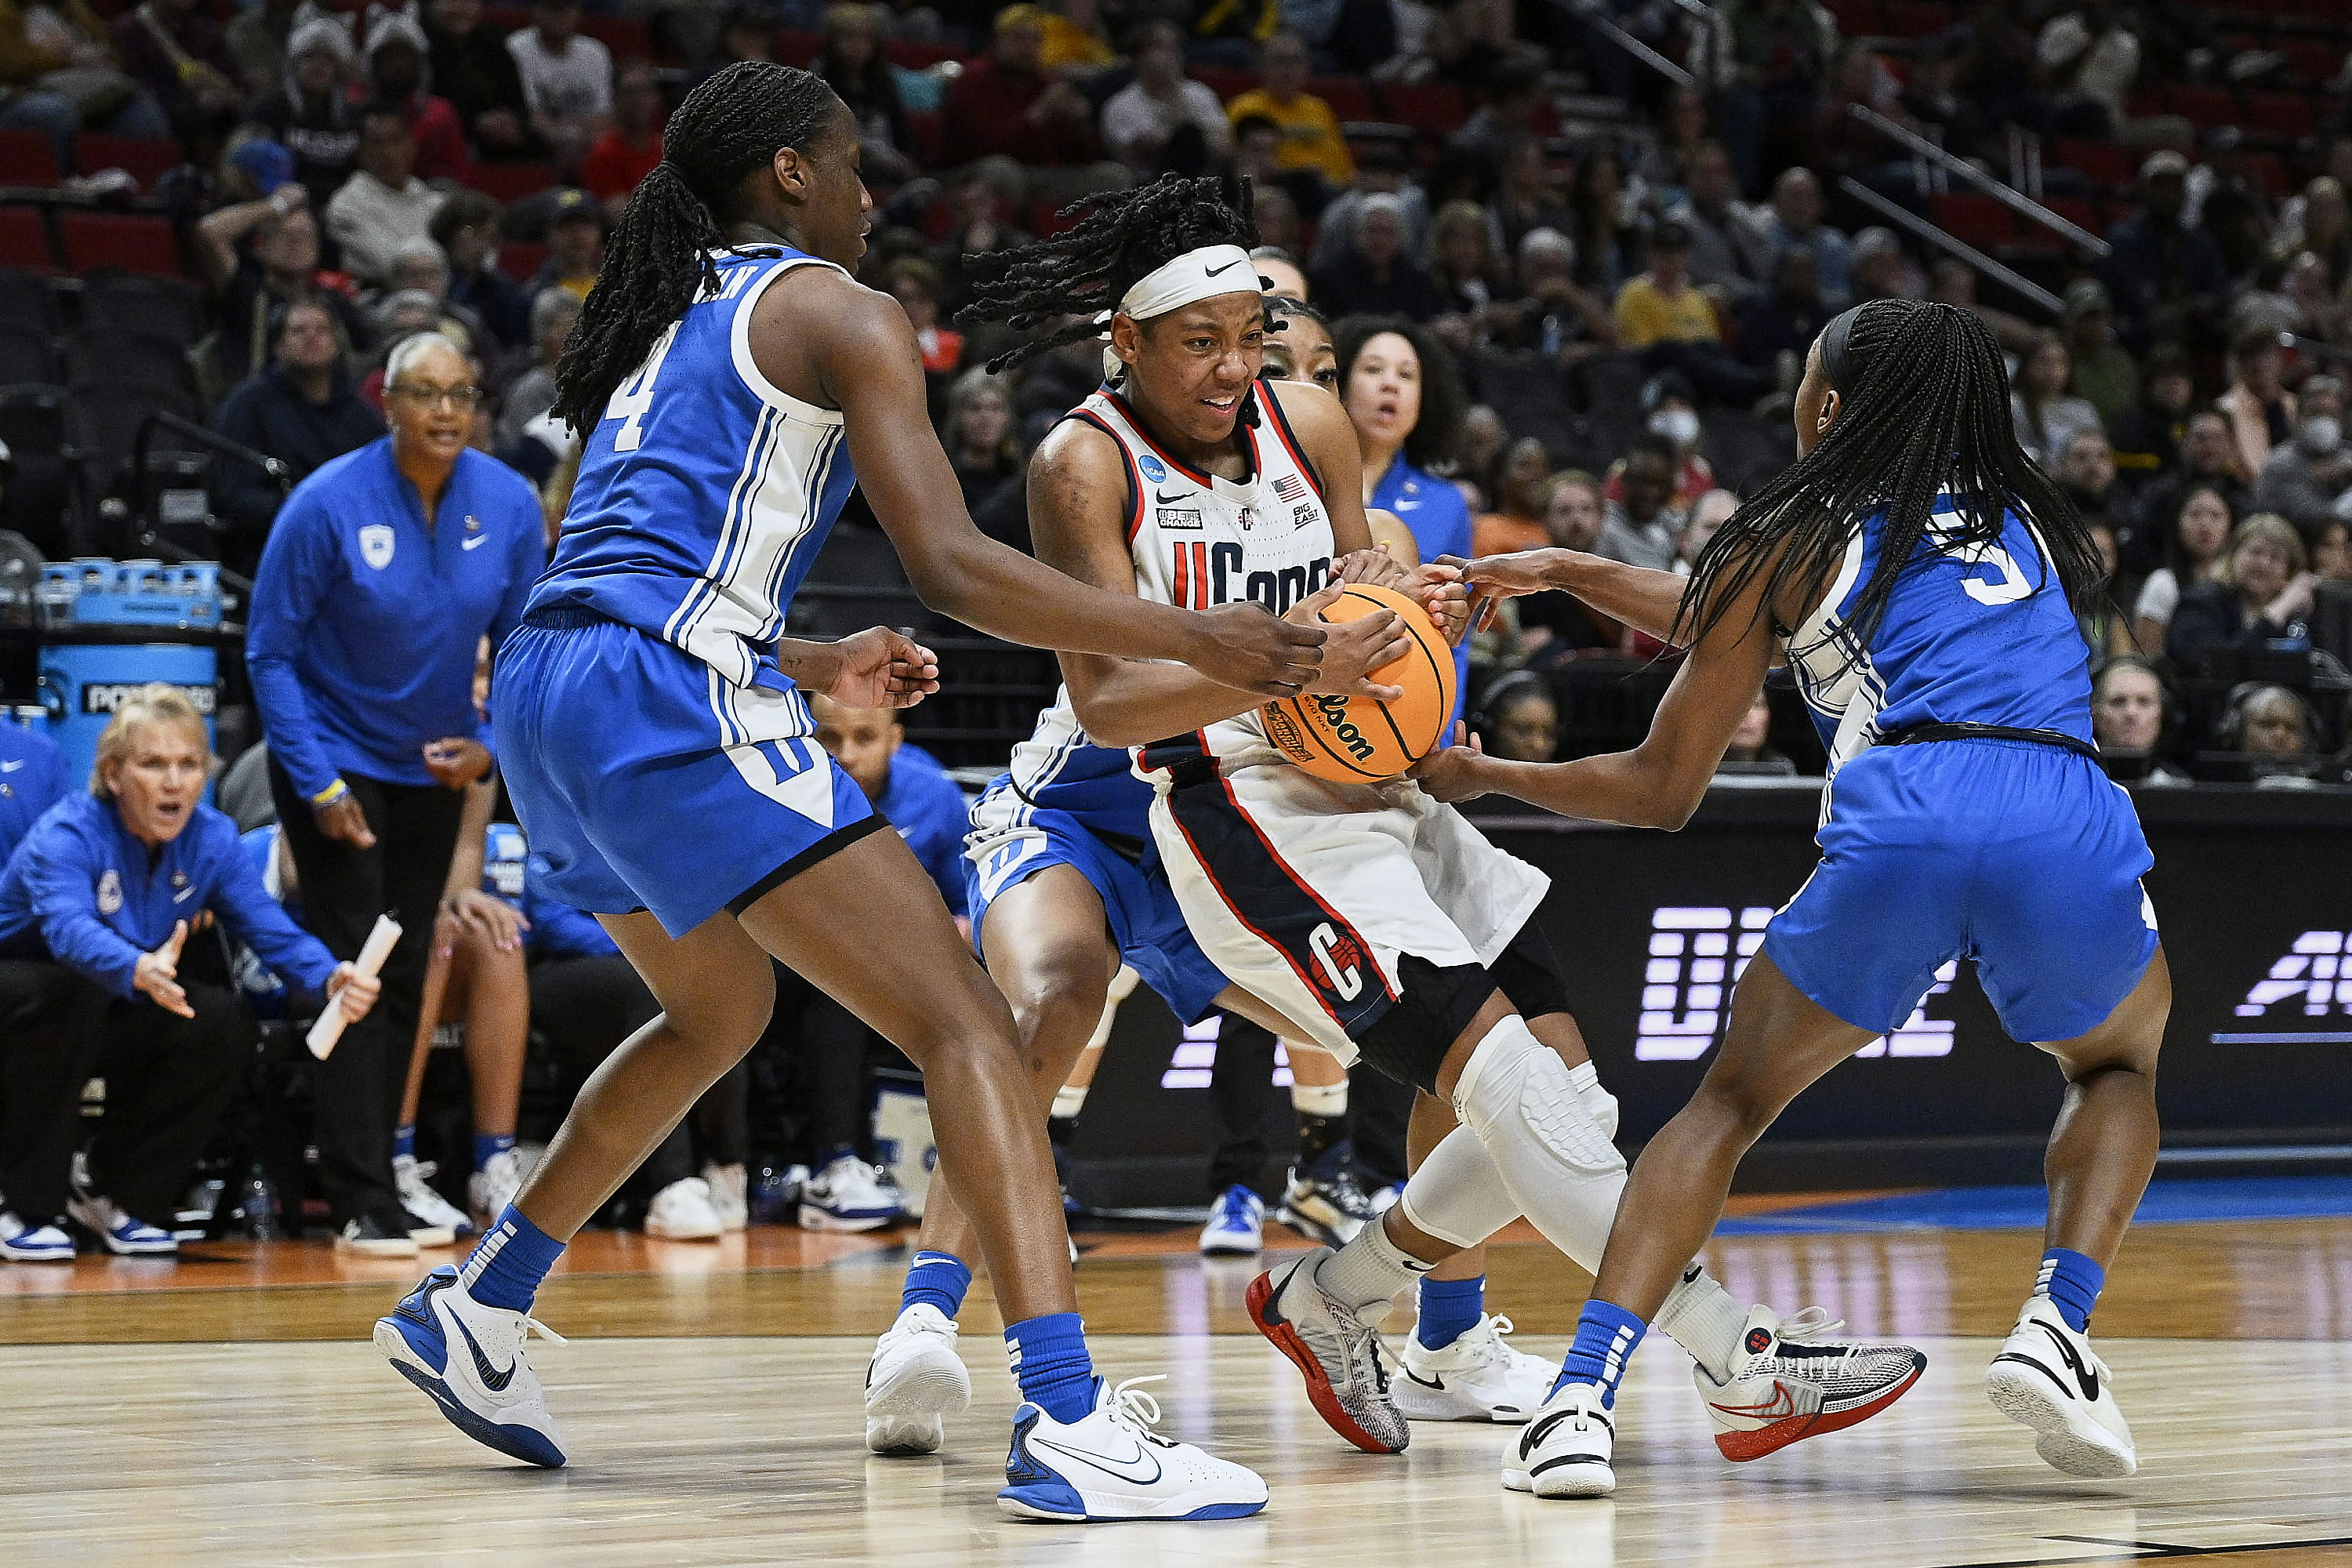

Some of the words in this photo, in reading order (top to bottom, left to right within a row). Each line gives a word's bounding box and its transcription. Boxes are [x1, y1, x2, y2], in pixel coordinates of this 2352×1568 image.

[603, 320, 682, 452] 4
[1293, 503, 1310, 516] BIG
[1294, 509, 1318, 525] EAST
[1310, 694, 1375, 762] lson
